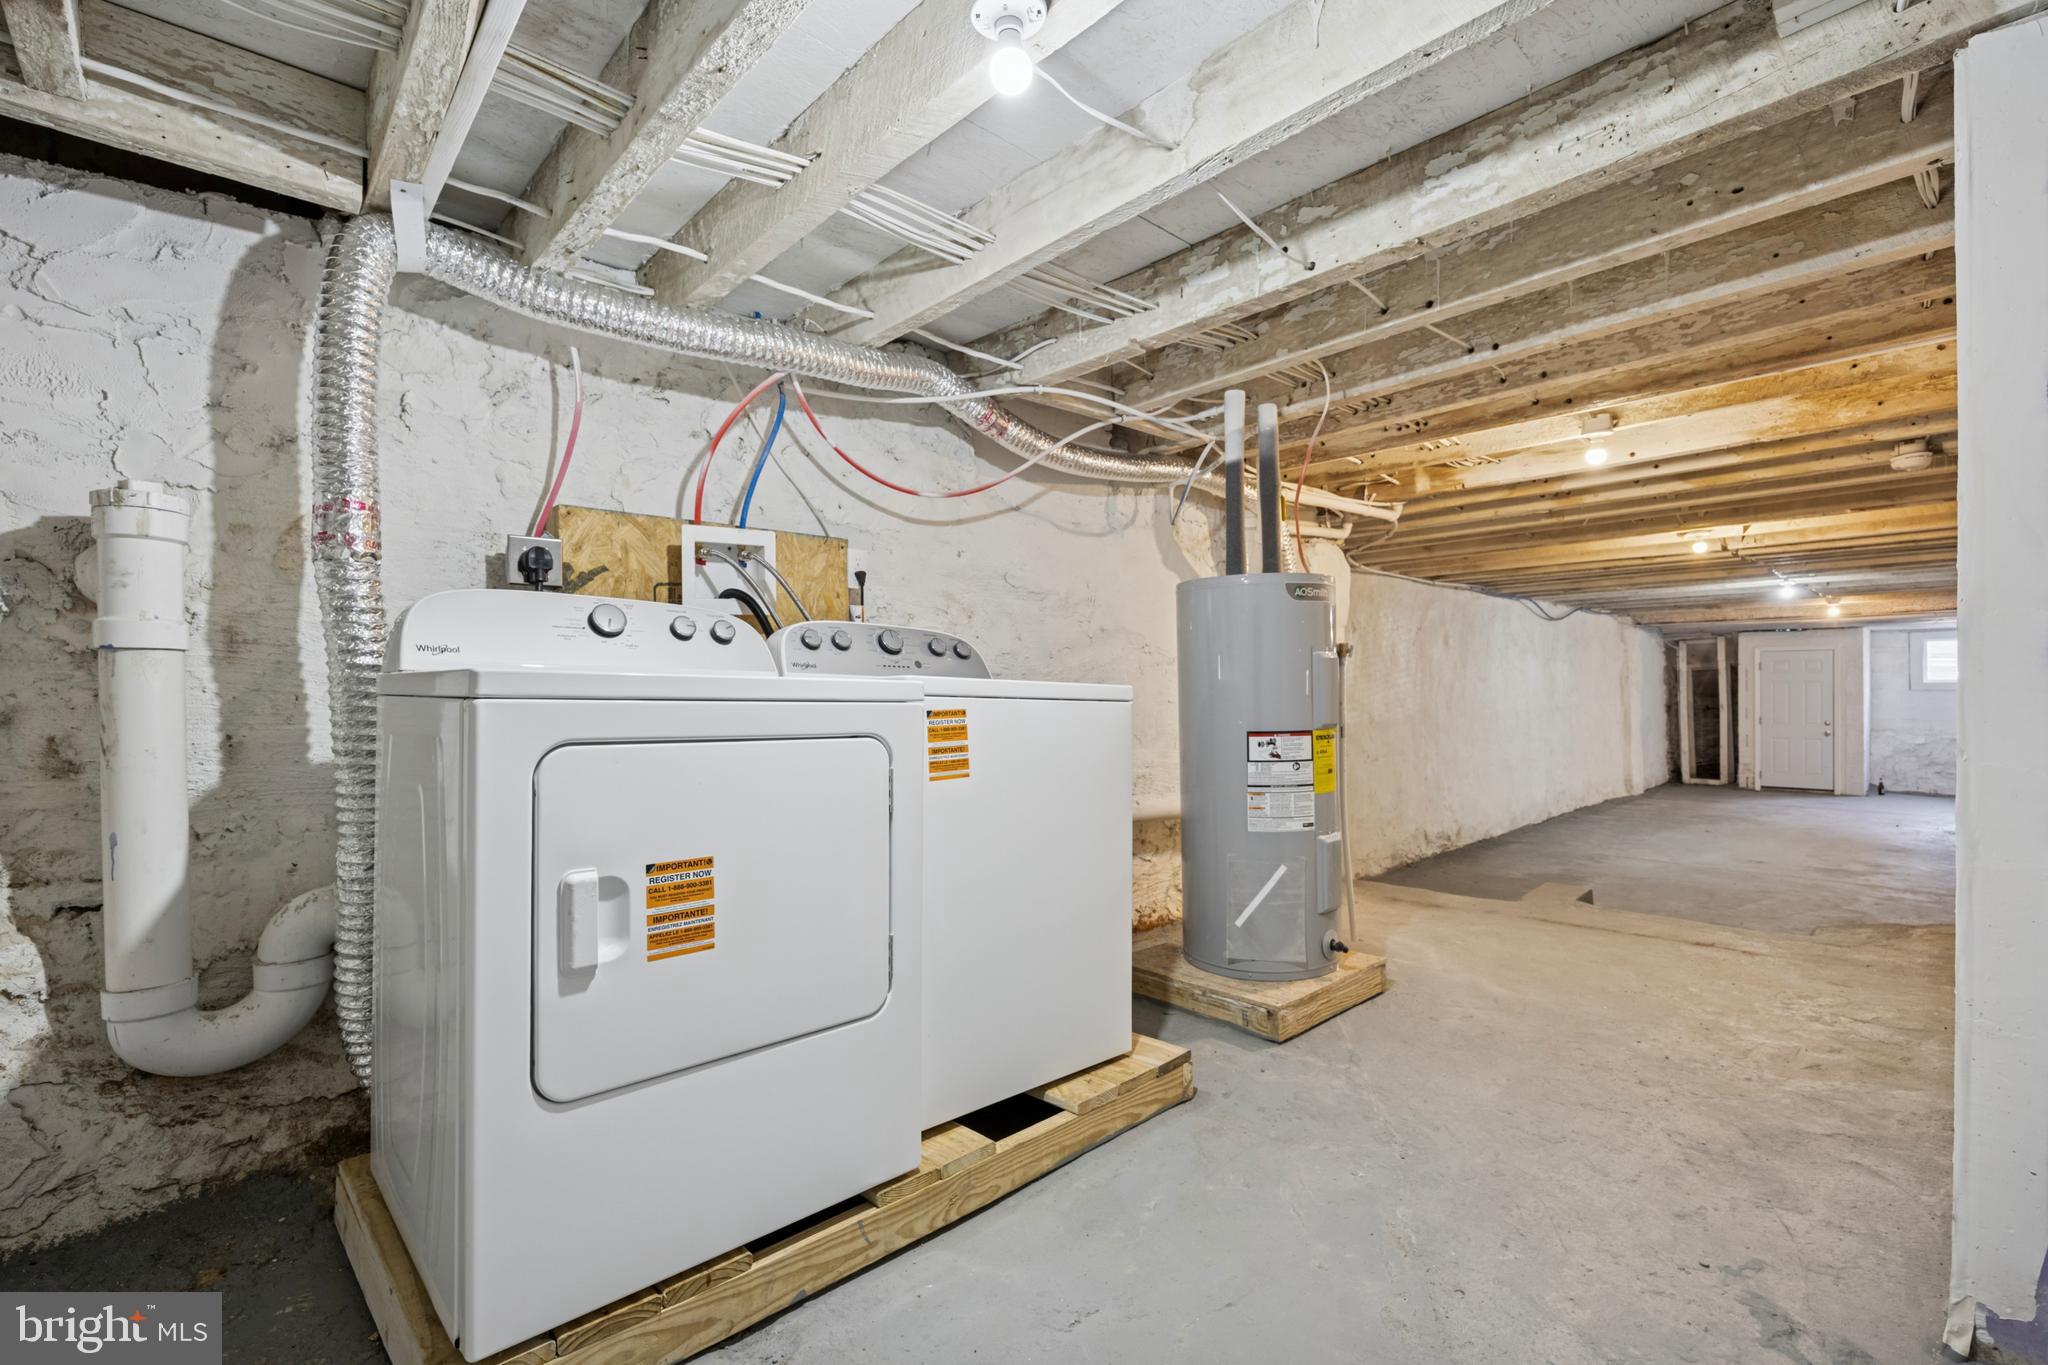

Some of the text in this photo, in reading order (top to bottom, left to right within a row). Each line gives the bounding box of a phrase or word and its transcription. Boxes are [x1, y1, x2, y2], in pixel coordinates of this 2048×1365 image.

[416, 644, 460, 656] Whirlpool
[656, 858, 706, 873] IMPORTANT!
[649, 869, 712, 885] REGISTER NOW
[648, 886, 666, 895] CALL
[652, 908, 708, 924] IMPORTANTE!
